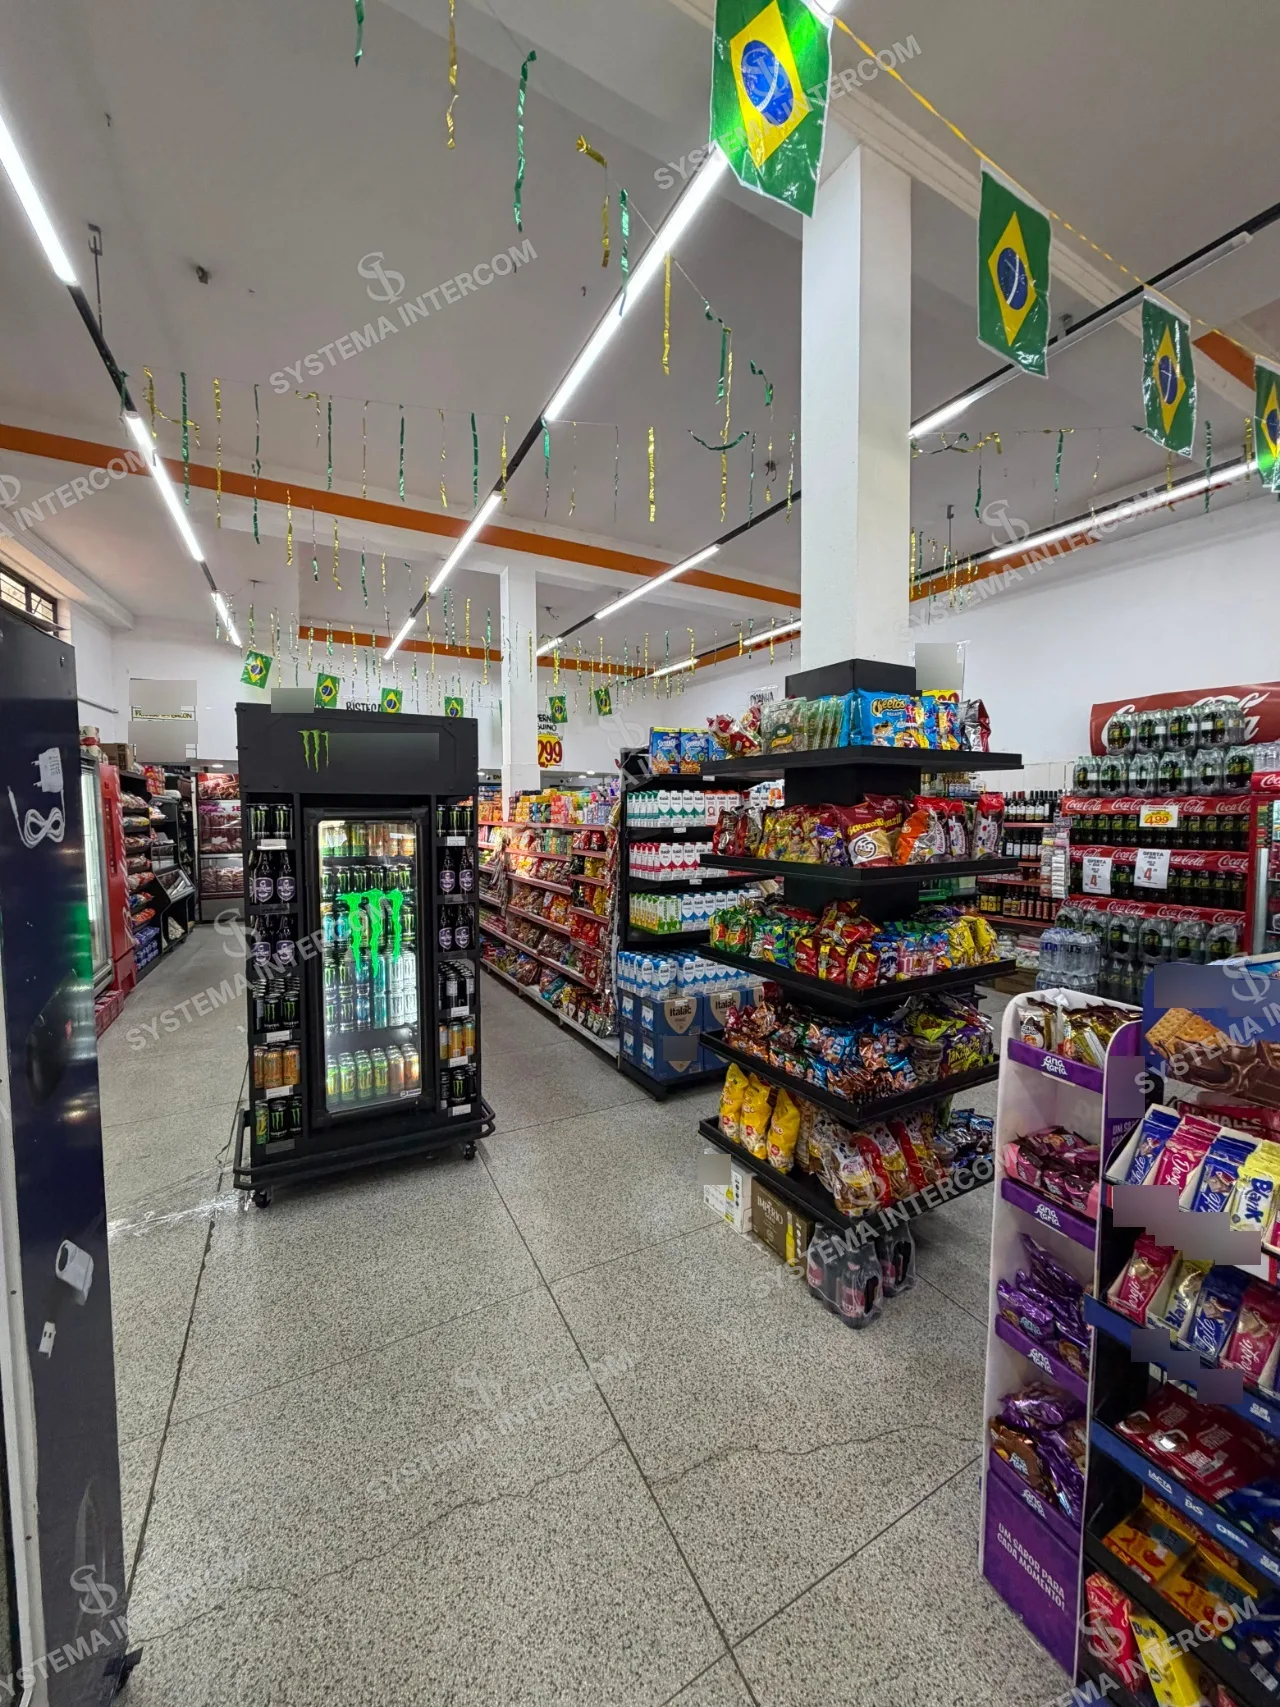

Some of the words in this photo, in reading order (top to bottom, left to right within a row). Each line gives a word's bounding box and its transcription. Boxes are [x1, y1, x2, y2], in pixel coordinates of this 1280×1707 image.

[872, 698, 906, 716] Cheetos
[670, 1006, 692, 1017] Italac
[715, 997, 737, 1010] Italac
[1207, 1114, 1262, 1129] HALLS
[1245, 1178, 1273, 1223] Blank
[998, 1522, 1011, 1543] UM
[1012, 1538, 1040, 1574] SABOR
[1041, 1568, 1065, 1600] PARA
[997, 1533, 1018, 1561] CADA
[1018, 1556, 1065, 1612] MOMENTO!
